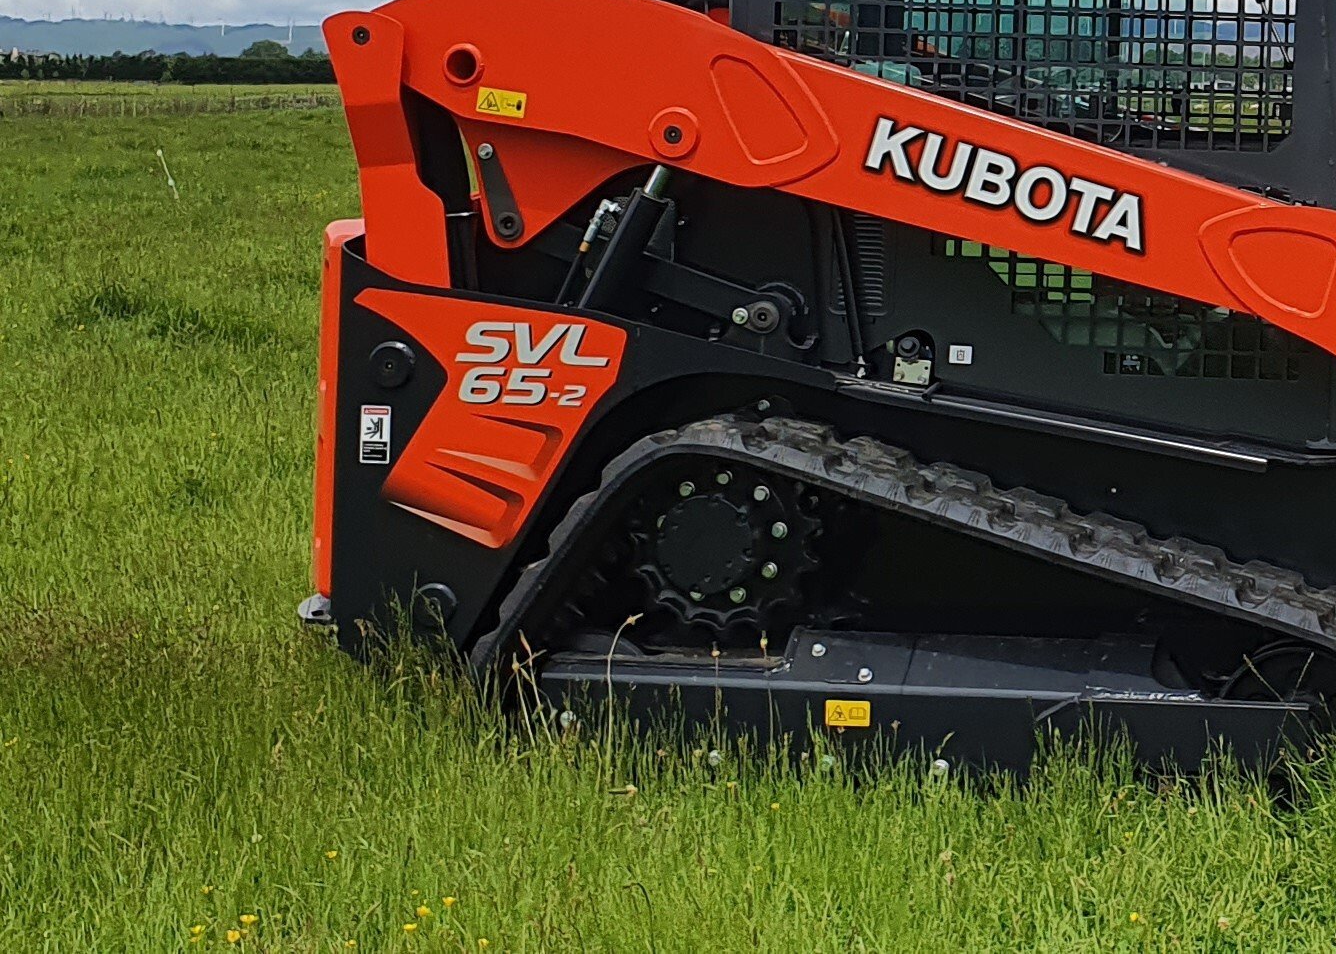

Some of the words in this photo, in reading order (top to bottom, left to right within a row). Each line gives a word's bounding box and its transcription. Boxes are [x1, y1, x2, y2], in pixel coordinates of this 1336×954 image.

[864, 116, 1144, 252] KUBOTA
[454, 321, 610, 367] SVL
[457, 366, 588, 407] 65-2
